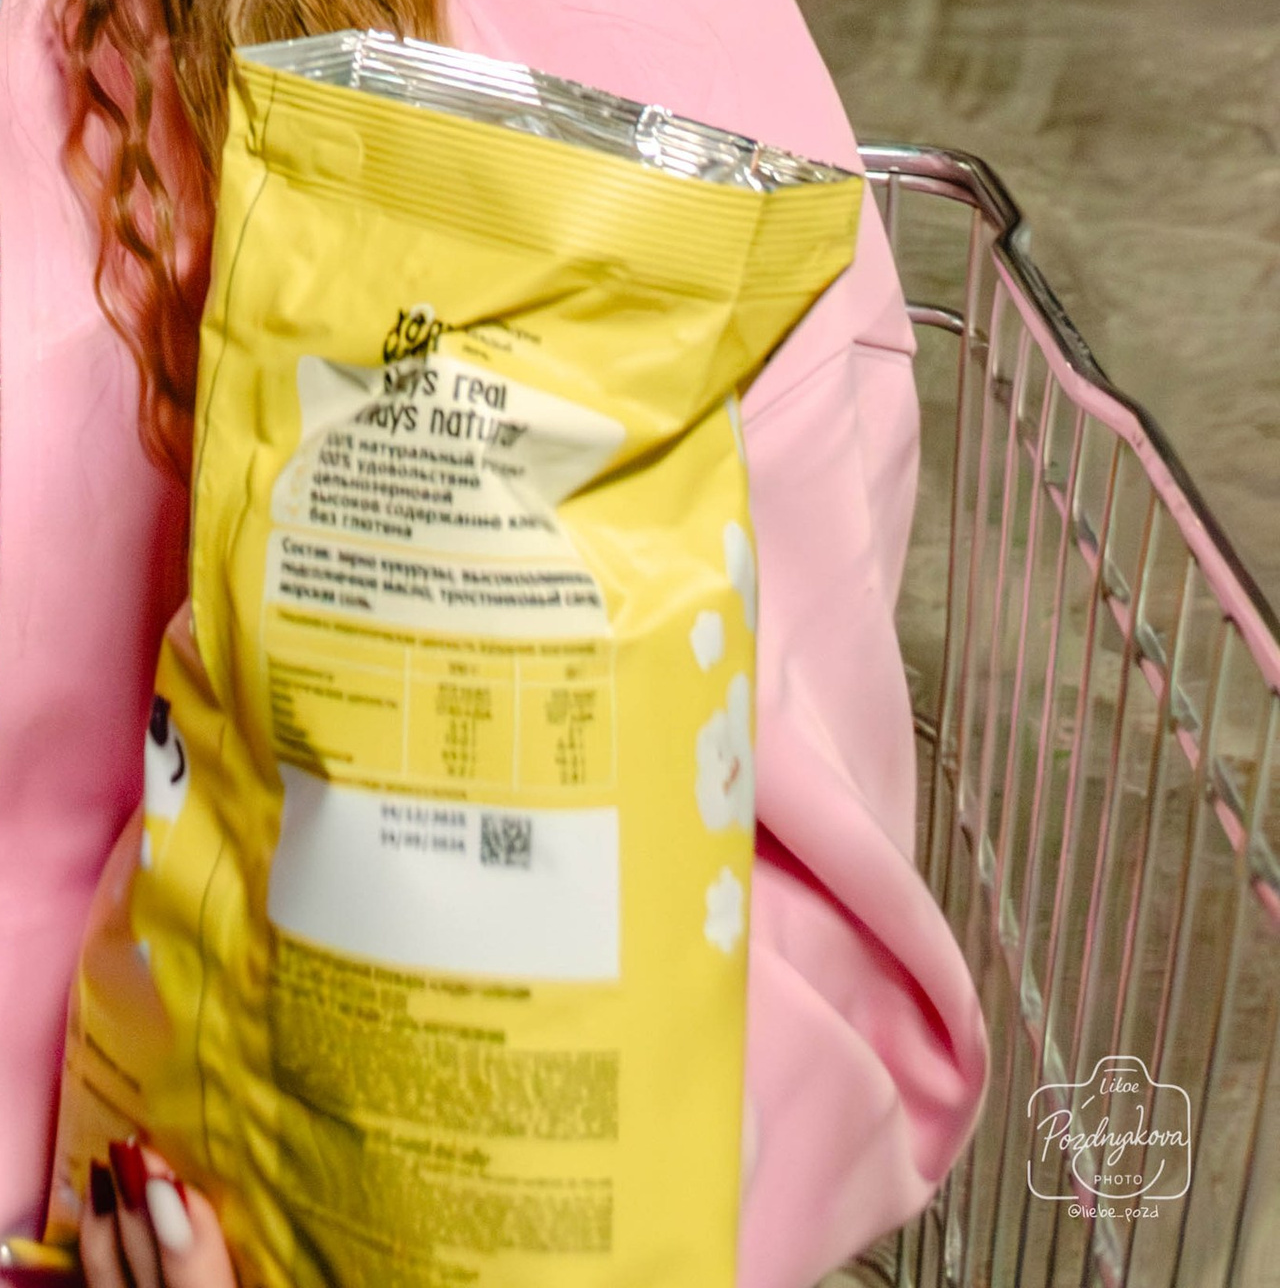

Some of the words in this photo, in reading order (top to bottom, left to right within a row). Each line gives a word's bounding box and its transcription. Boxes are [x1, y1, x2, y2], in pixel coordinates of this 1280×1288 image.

[452, 373, 508, 412] real
[358, 439, 475, 467] натуральный
[385, 503, 502, 530] содержание
